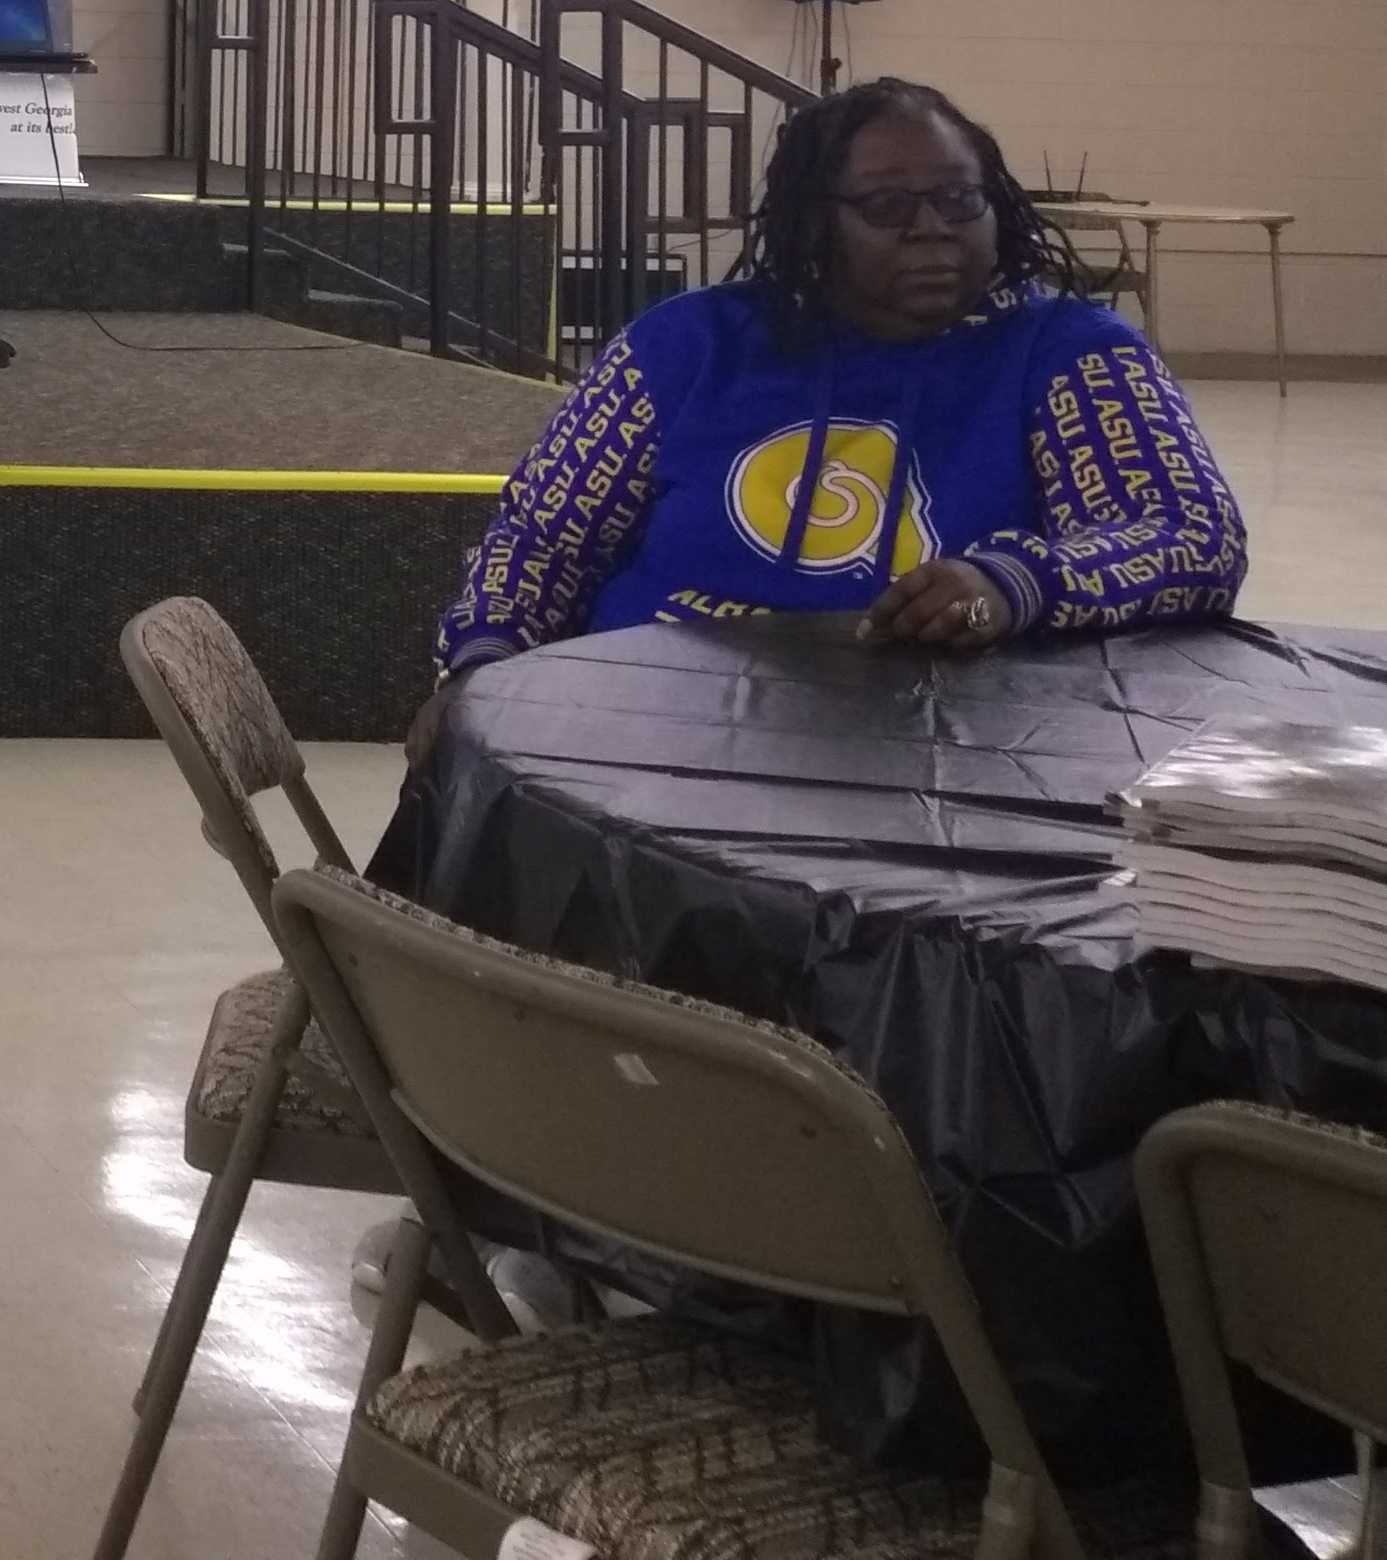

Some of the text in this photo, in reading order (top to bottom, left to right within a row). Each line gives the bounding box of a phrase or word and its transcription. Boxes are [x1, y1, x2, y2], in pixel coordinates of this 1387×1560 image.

[25, 102, 73, 118] Georgia
[10, 122, 23, 133] at
[27, 122, 42, 133] its
